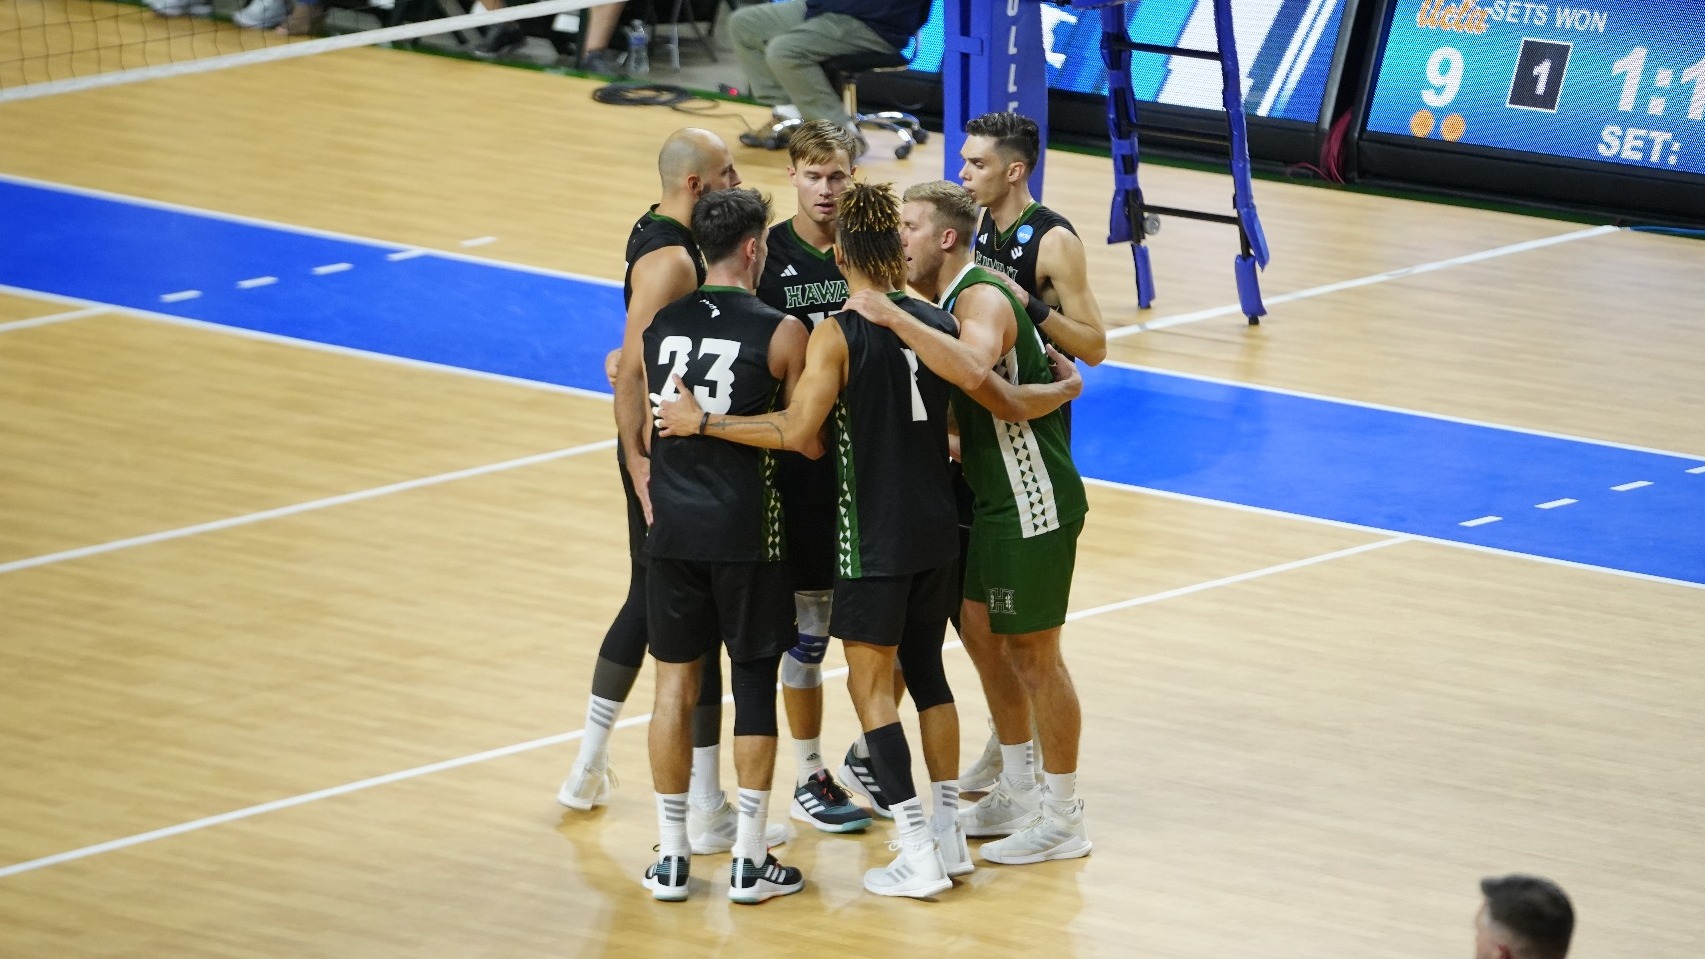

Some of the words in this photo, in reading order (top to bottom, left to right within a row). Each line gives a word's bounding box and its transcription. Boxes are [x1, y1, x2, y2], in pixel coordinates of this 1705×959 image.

[1487, 0, 1548, 26] SETS
[1555, 6, 1608, 33] WON
[1421, 47, 1464, 107] 9
[1532, 58, 1552, 96] 1
[1598, 125, 1681, 165] SET:
[784, 280, 850, 309] HAWA
[657, 335, 742, 415] 23
